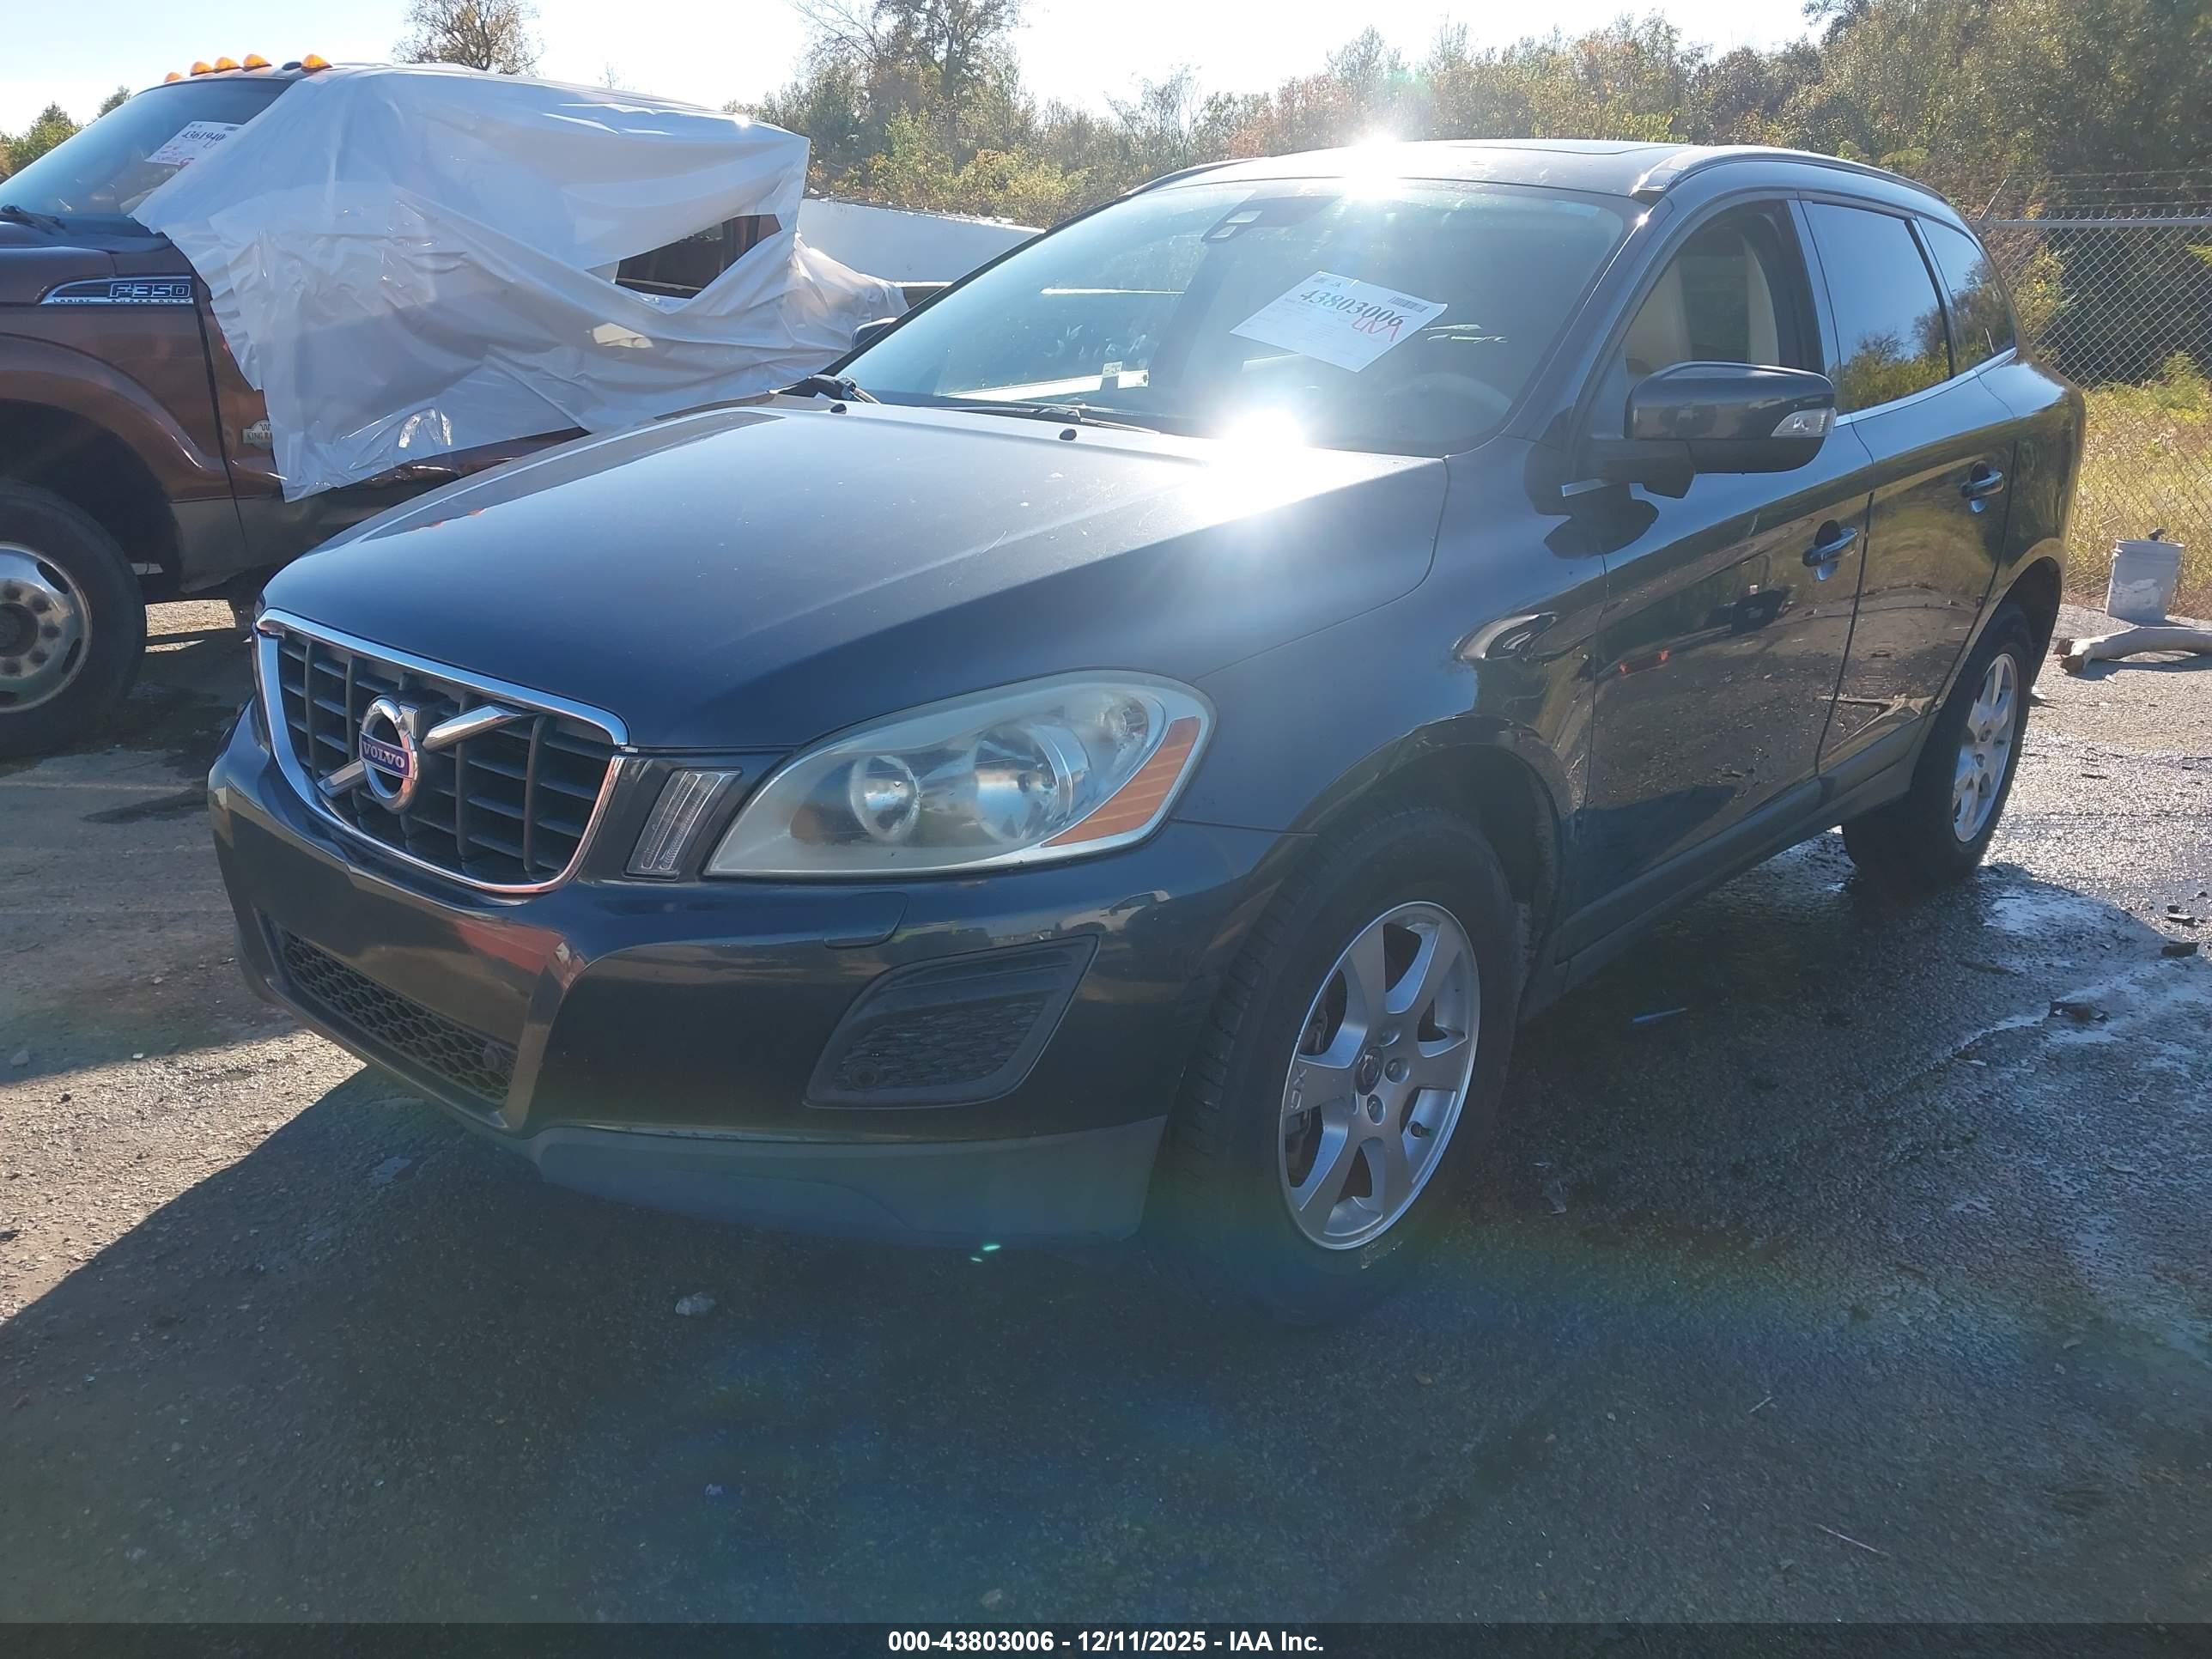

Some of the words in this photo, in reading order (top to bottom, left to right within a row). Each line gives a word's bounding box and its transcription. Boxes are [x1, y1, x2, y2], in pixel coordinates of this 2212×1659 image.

[109, 283, 191, 298] F-350
[1299, 289, 1412, 327] 43803006
[362, 741, 405, 769] VOLVO
